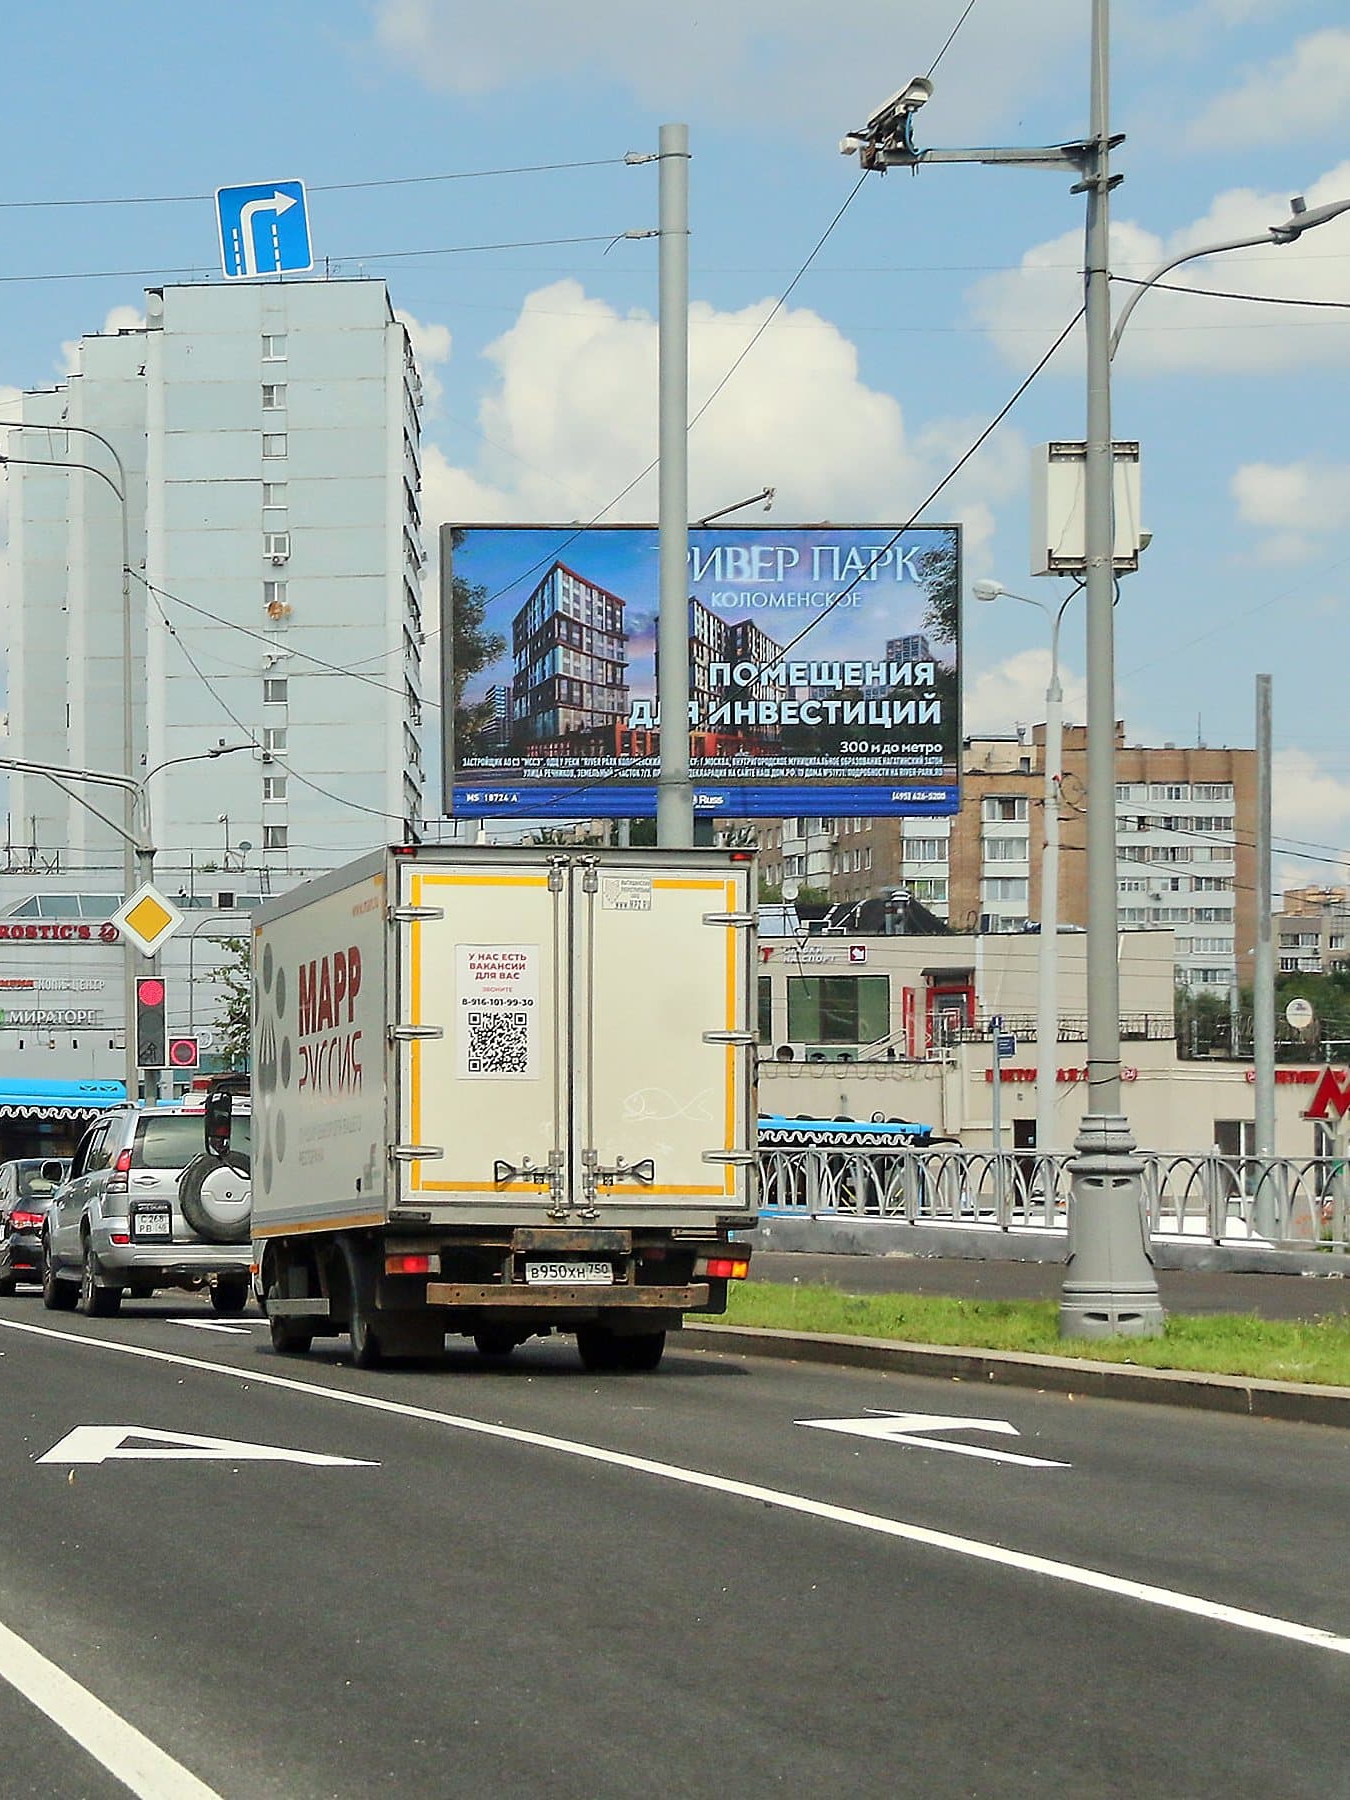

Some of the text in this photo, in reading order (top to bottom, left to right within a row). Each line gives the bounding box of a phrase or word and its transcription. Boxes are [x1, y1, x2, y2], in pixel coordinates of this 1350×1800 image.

[813, 545, 924, 583] ПАРК
[711, 590, 862, 608] КОЛОМЕНСКОЕ
[709, 661, 935, 690] ПОМЕЩЕНИЯ
[710, 693, 942, 729] ИНВЕСТИЦИЙ
[840, 741, 869, 753] 300
[882, 743, 900, 755] до
[901, 743, 943, 756] метро
[468, 953, 527, 961] У НАС ЕСТЬ
[469, 962, 526, 971] ВАКАНСИИ
[474, 971, 520, 980] ДЛЯ ВАС
[298, 945, 362, 1038] МАРР
[461, 998, 534, 1006] 8-916-101-99-30
[9, 1009, 96, 1026] МИРАТОРГ
[530, 1263, 609, 1279] В950ХН 750
